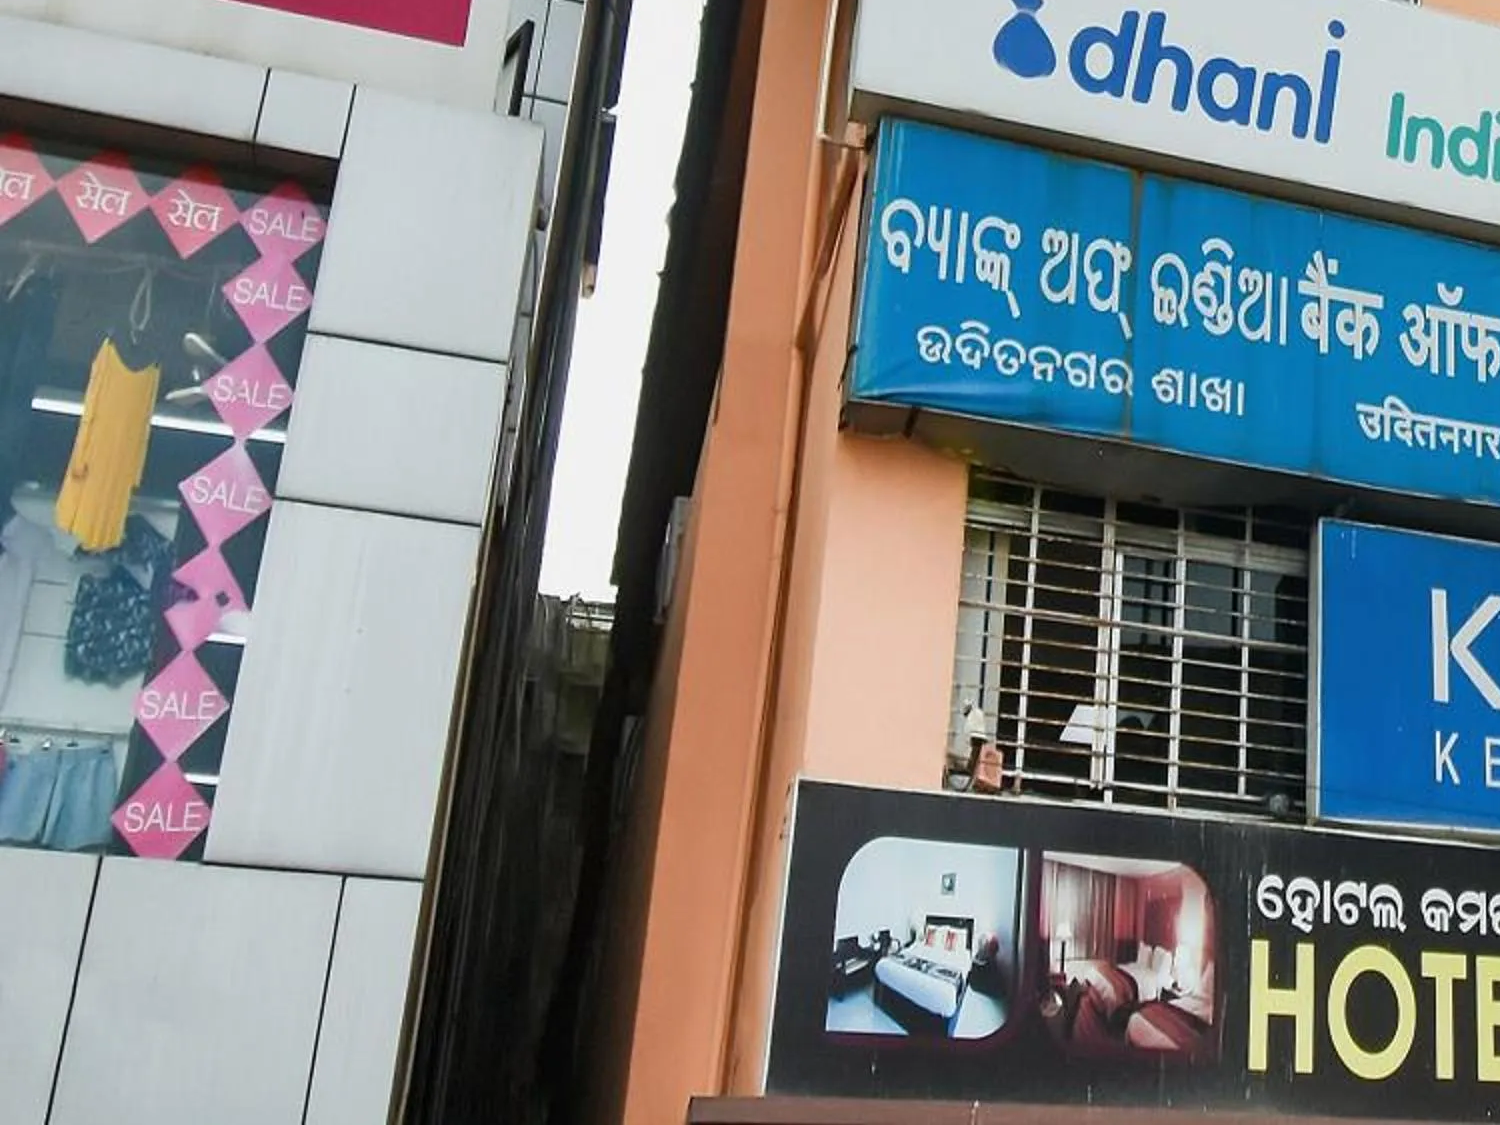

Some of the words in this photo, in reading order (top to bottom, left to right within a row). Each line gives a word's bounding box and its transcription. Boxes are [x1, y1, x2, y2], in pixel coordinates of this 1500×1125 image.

[1068, 10, 1345, 144] dhani
[75, 171, 131, 217] सेल
[167, 189, 225, 232] सेल
[250, 209, 322, 243] SALE
[233, 278, 307, 312] SALE
[1298, 251, 1385, 360] बैंक
[213, 376, 287, 411] SALE
[189, 477, 265, 514] SALE
[140, 691, 219, 721] SALE
[123, 802, 207, 833] SALE
